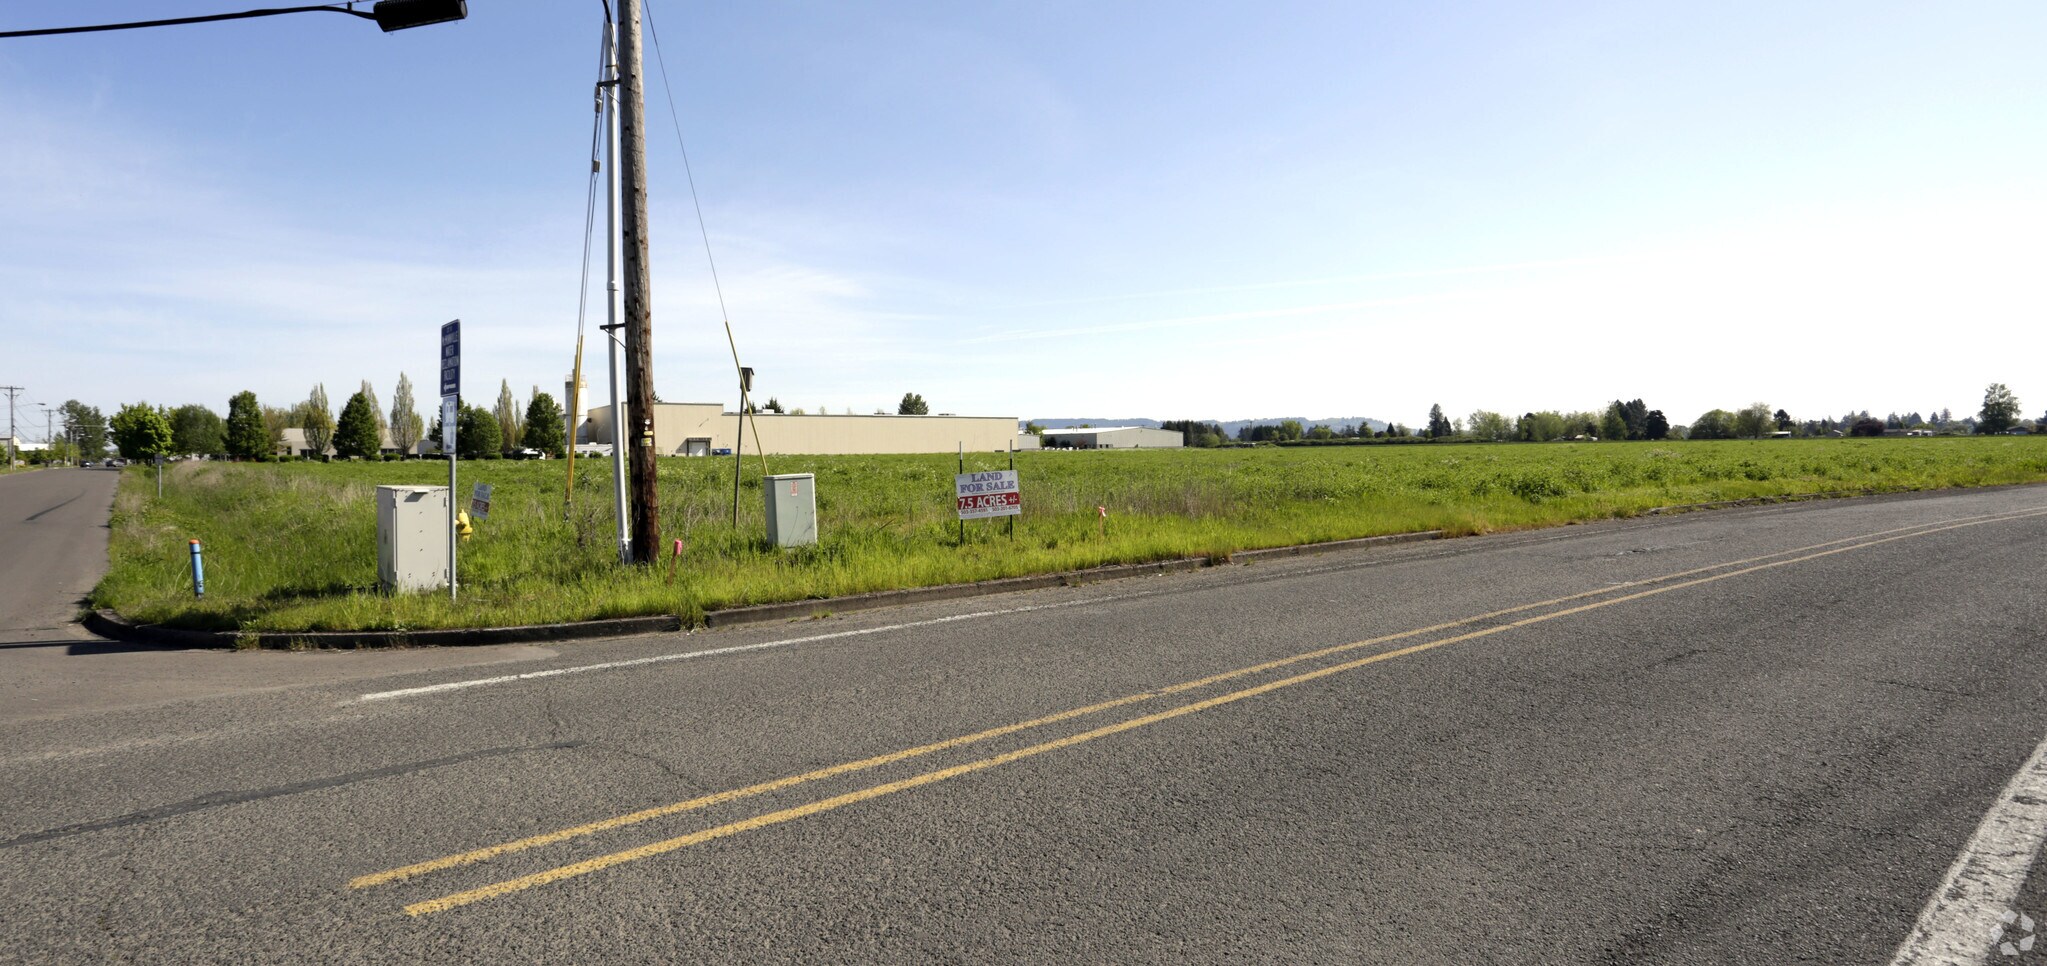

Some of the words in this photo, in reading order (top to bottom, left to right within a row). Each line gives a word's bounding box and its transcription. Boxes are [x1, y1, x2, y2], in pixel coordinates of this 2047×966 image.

[971, 472, 1002, 482] LAND
[960, 483, 984, 493] FOR
[986, 481, 1014, 490] SALE
[960, 498, 973, 509] 7.5
[977, 495, 1007, 507] ACRES
